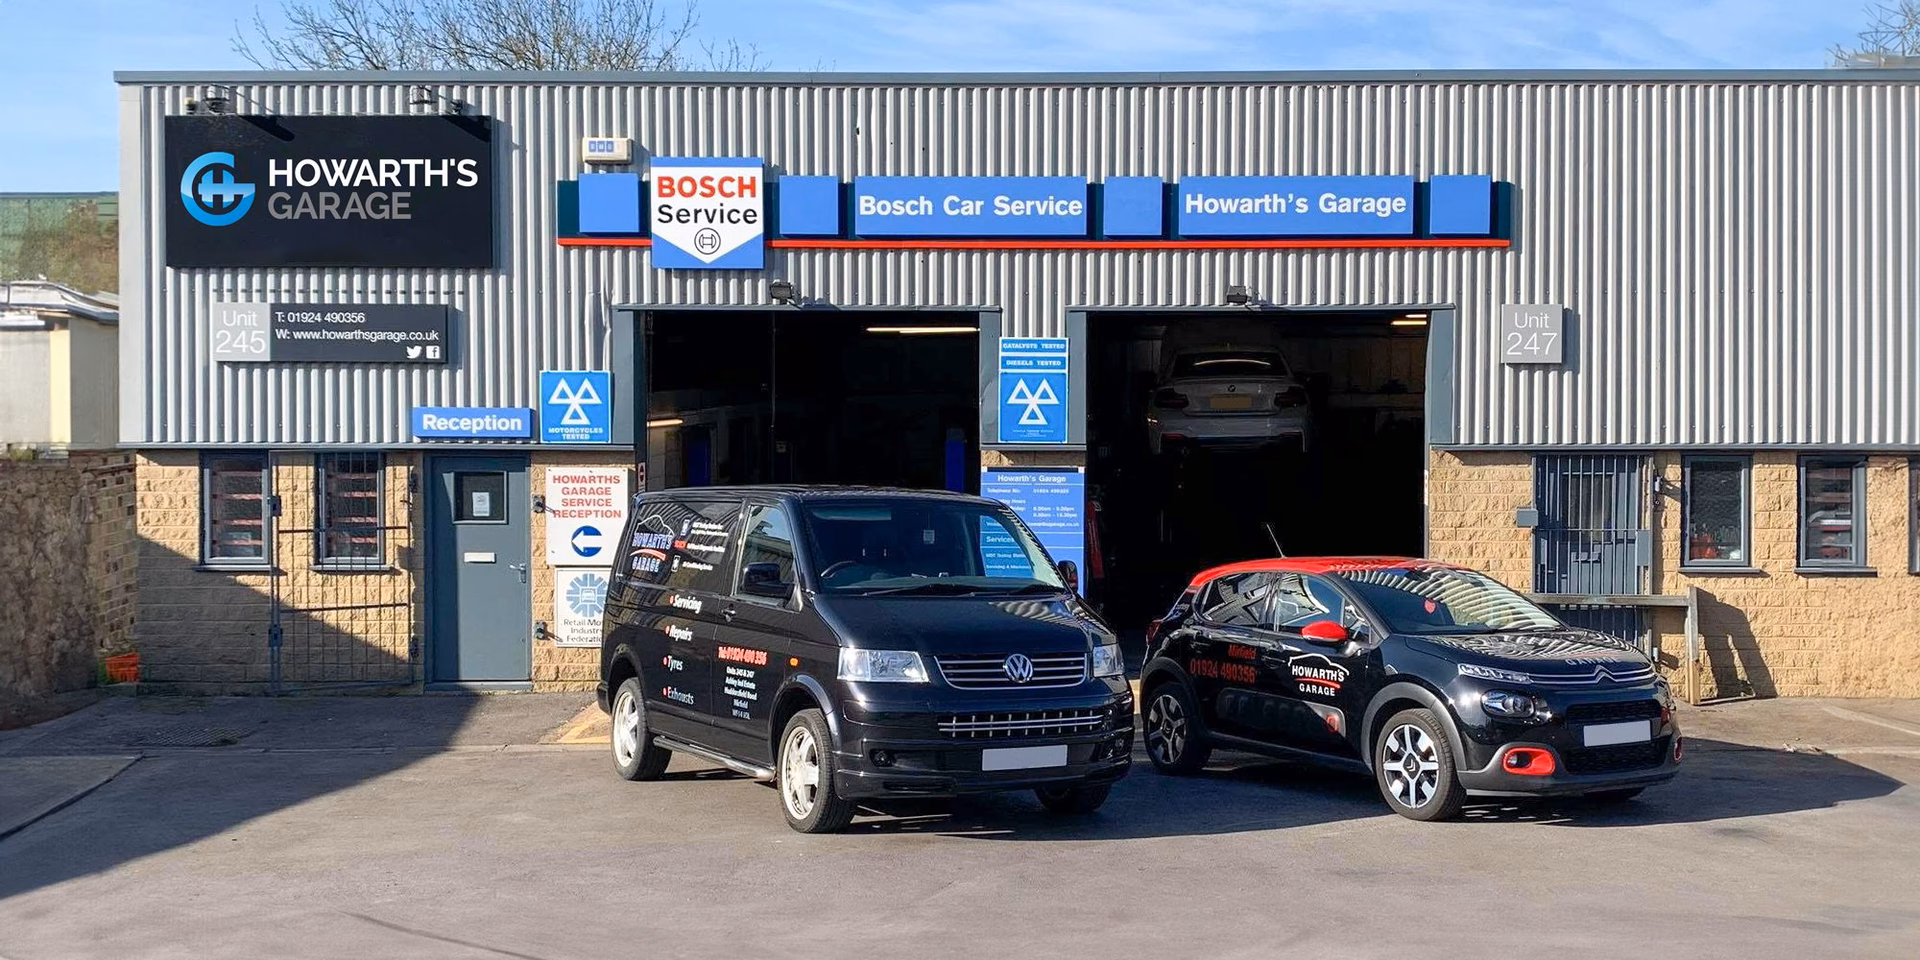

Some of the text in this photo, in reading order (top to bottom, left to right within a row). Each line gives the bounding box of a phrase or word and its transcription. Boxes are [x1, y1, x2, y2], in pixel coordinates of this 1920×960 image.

[269, 158, 478, 187] HOWARTH'S
[658, 176, 756, 198] BOSCH
[268, 192, 412, 220] GARAGE
[657, 203, 758, 224] Service
[859, 195, 1083, 216] Bosch Car Service
[1185, 193, 1407, 217] Howarth's Garage
[223, 310, 258, 327] Unit
[275, 311, 366, 323] T: 01924 490356
[1514, 312, 1550, 329] Unit
[215, 329, 266, 354] 245
[275, 328, 439, 343] W: www.howarthsgarage.co.uk
[1506, 332, 1558, 355] 247
[422, 413, 522, 434] Reception
[552, 475, 621, 484] HOWARTHS
[1038, 474, 1067, 484] Garage
[561, 487, 612, 495] GARAGE
[561, 498, 613, 507] SERVICE
[553, 509, 622, 518] RECEPTION
[632, 556, 662, 573] GARAGE
[673, 594, 702, 614] Servicing
[563, 619, 586, 627] Retail
[669, 624, 693, 641] Repairs
[667, 655, 684, 671] Tyres
[1190, 658, 1218, 678] 01924
[1292, 665, 1345, 682] HOWARTH'S
[667, 686, 694, 705] Exhausts
[1299, 683, 1336, 697] GARAGE
